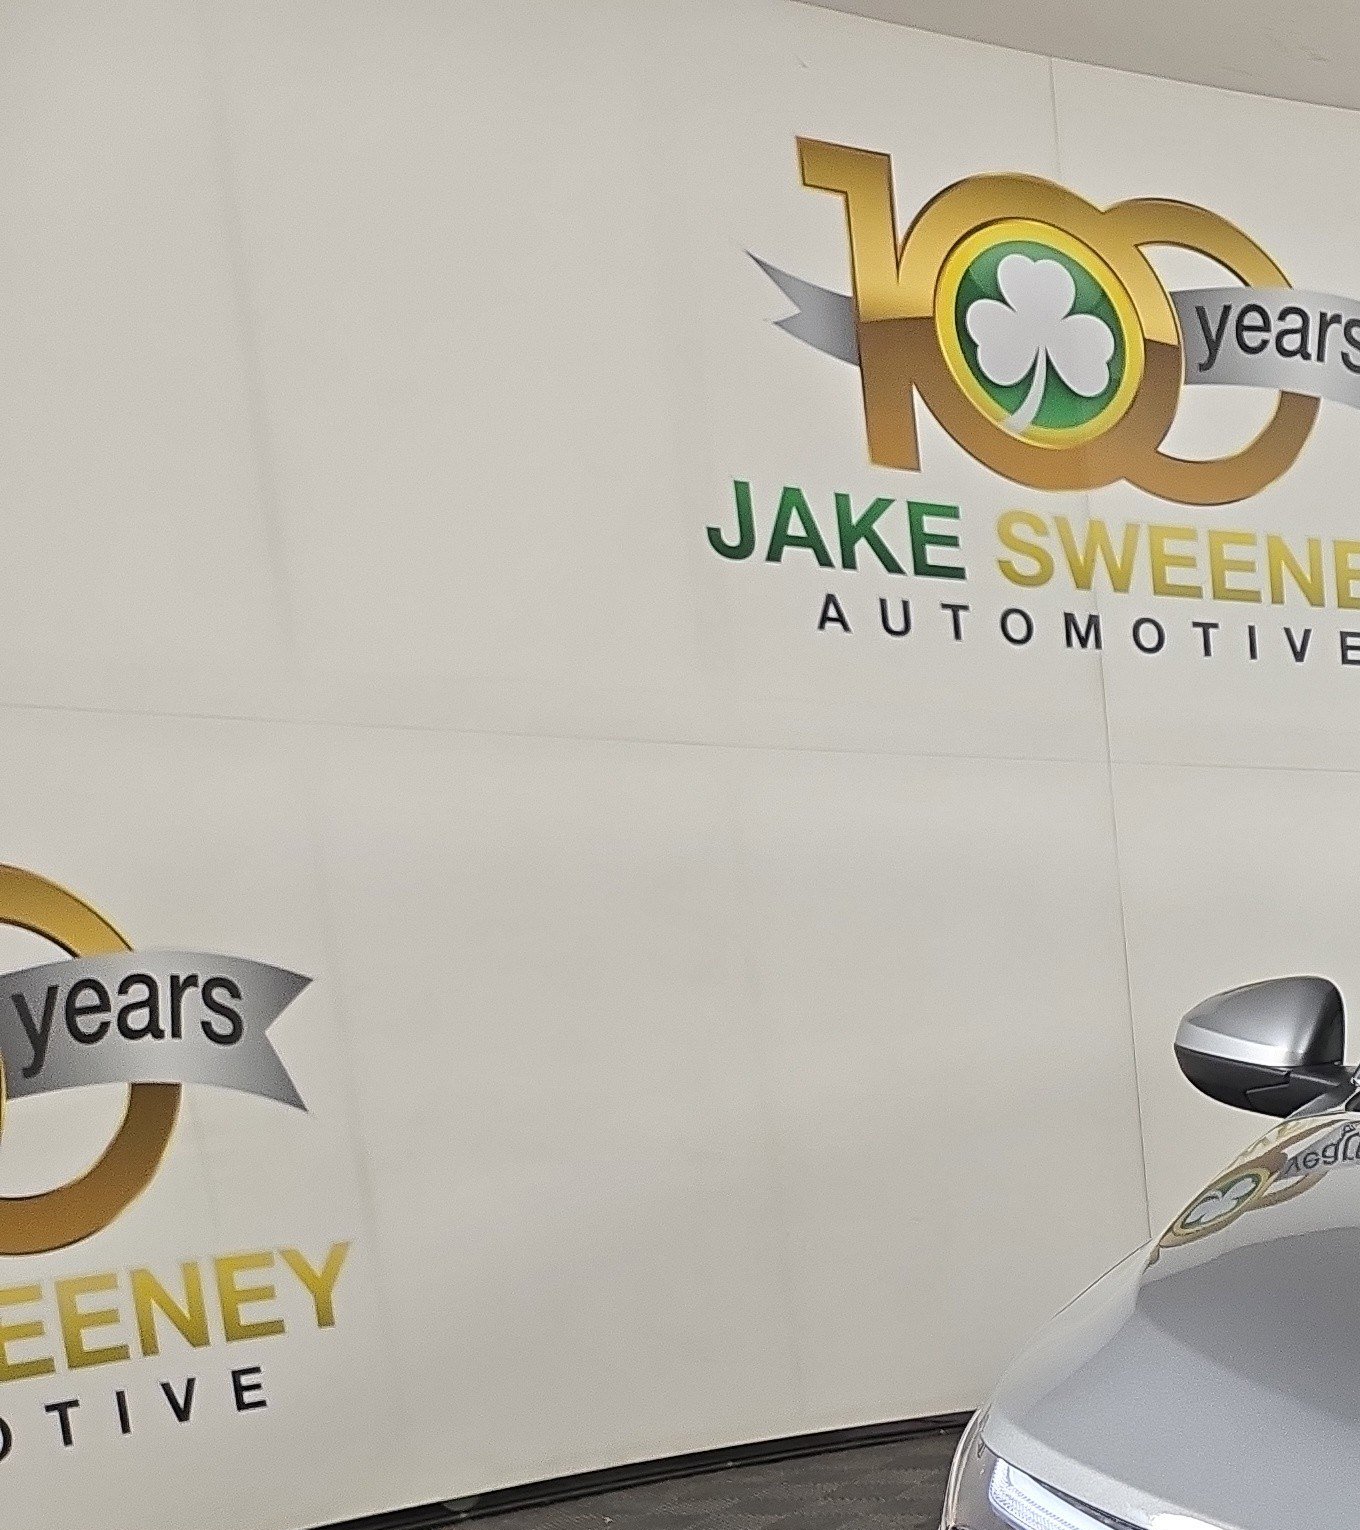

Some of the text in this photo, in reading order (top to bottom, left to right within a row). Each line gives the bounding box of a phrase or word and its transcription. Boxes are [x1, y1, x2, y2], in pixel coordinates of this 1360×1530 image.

[796, 136, 1321, 506] 100
[706, 480, 967, 581] JAKE
[11, 971, 244, 1078] years
[0, 1366, 267, 1461] TIVE
